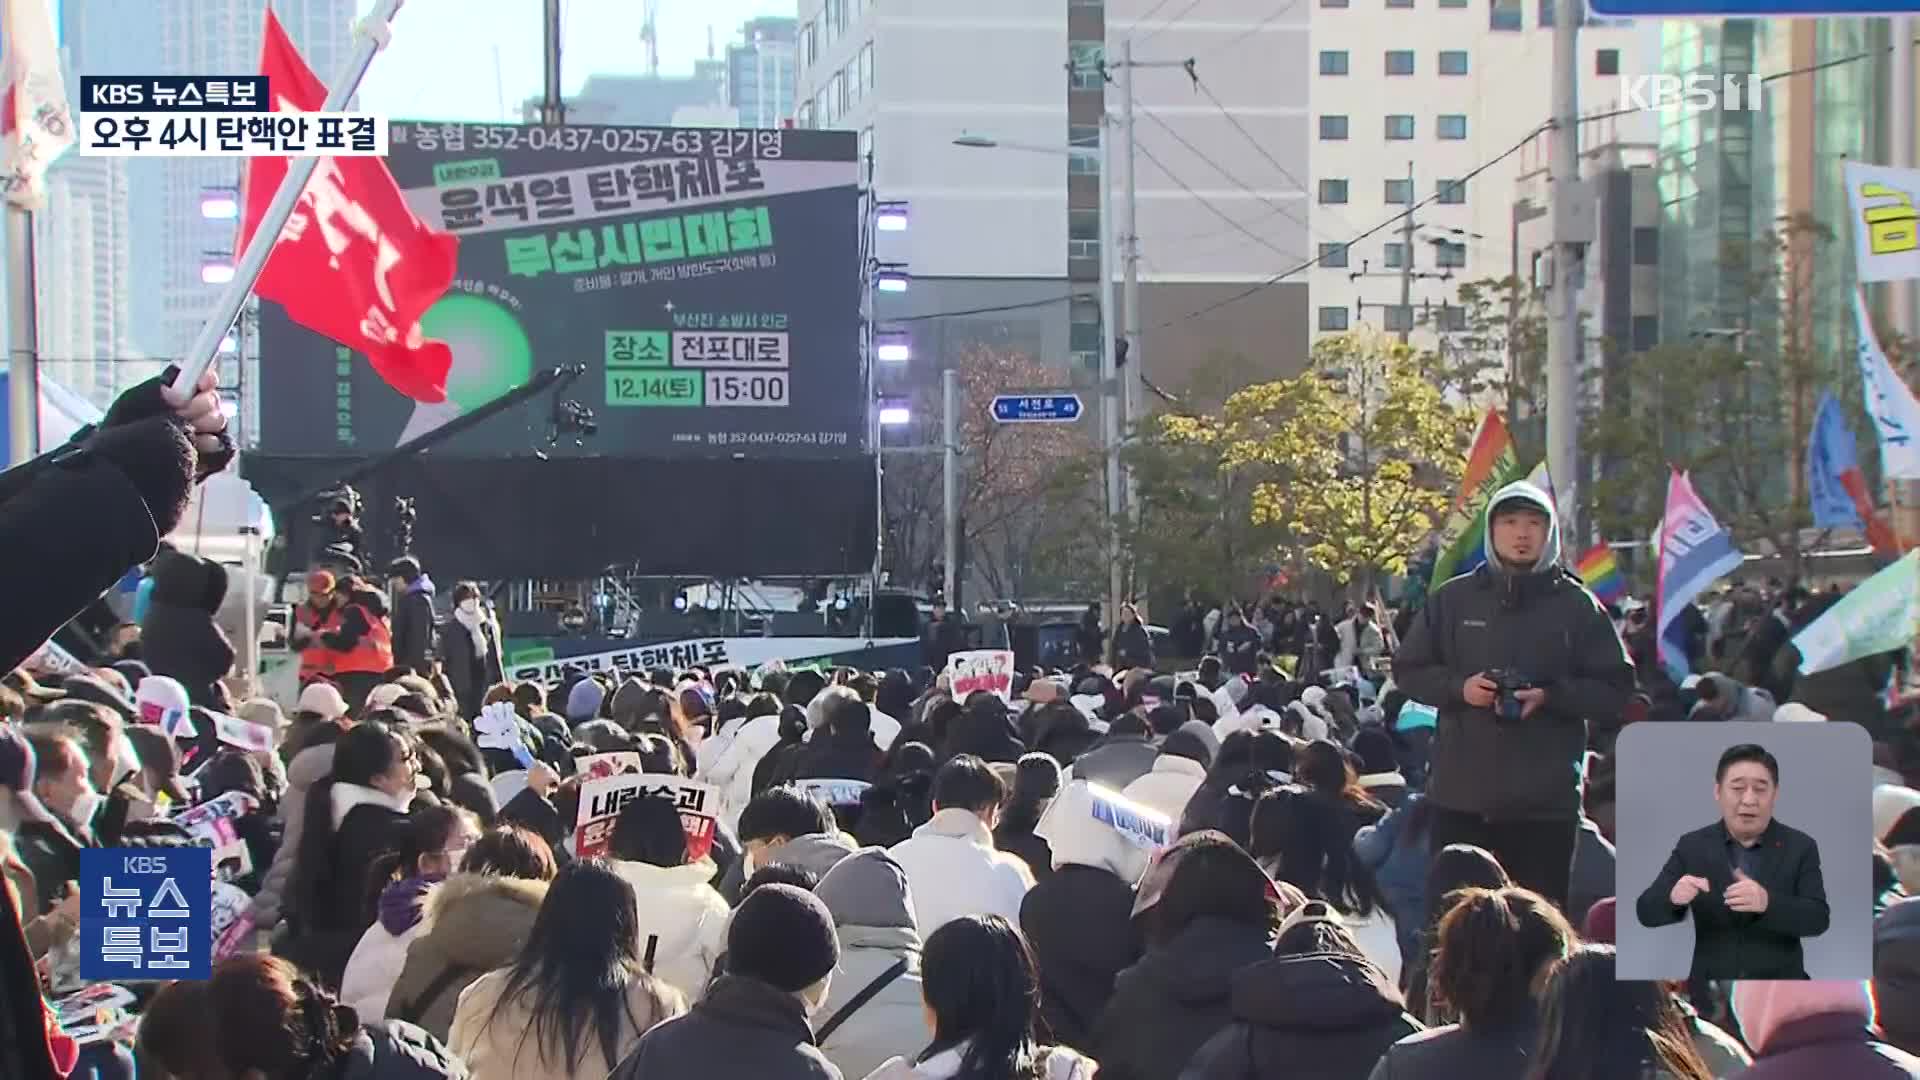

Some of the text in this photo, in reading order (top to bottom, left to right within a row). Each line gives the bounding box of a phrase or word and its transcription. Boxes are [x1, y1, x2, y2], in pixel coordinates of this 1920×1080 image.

[415, 121, 465, 151] 농협
[472, 126, 702, 154] 352-0437-0257-63
[710, 130, 783, 159] 김기영
[440, 158, 766, 230] 윤석열 탄핵체포
[504, 205, 774, 277] 부산시민대회
[611, 336, 783, 362] 장소 전포대로
[613, 376, 785, 402] 12.14(토) 15:00
